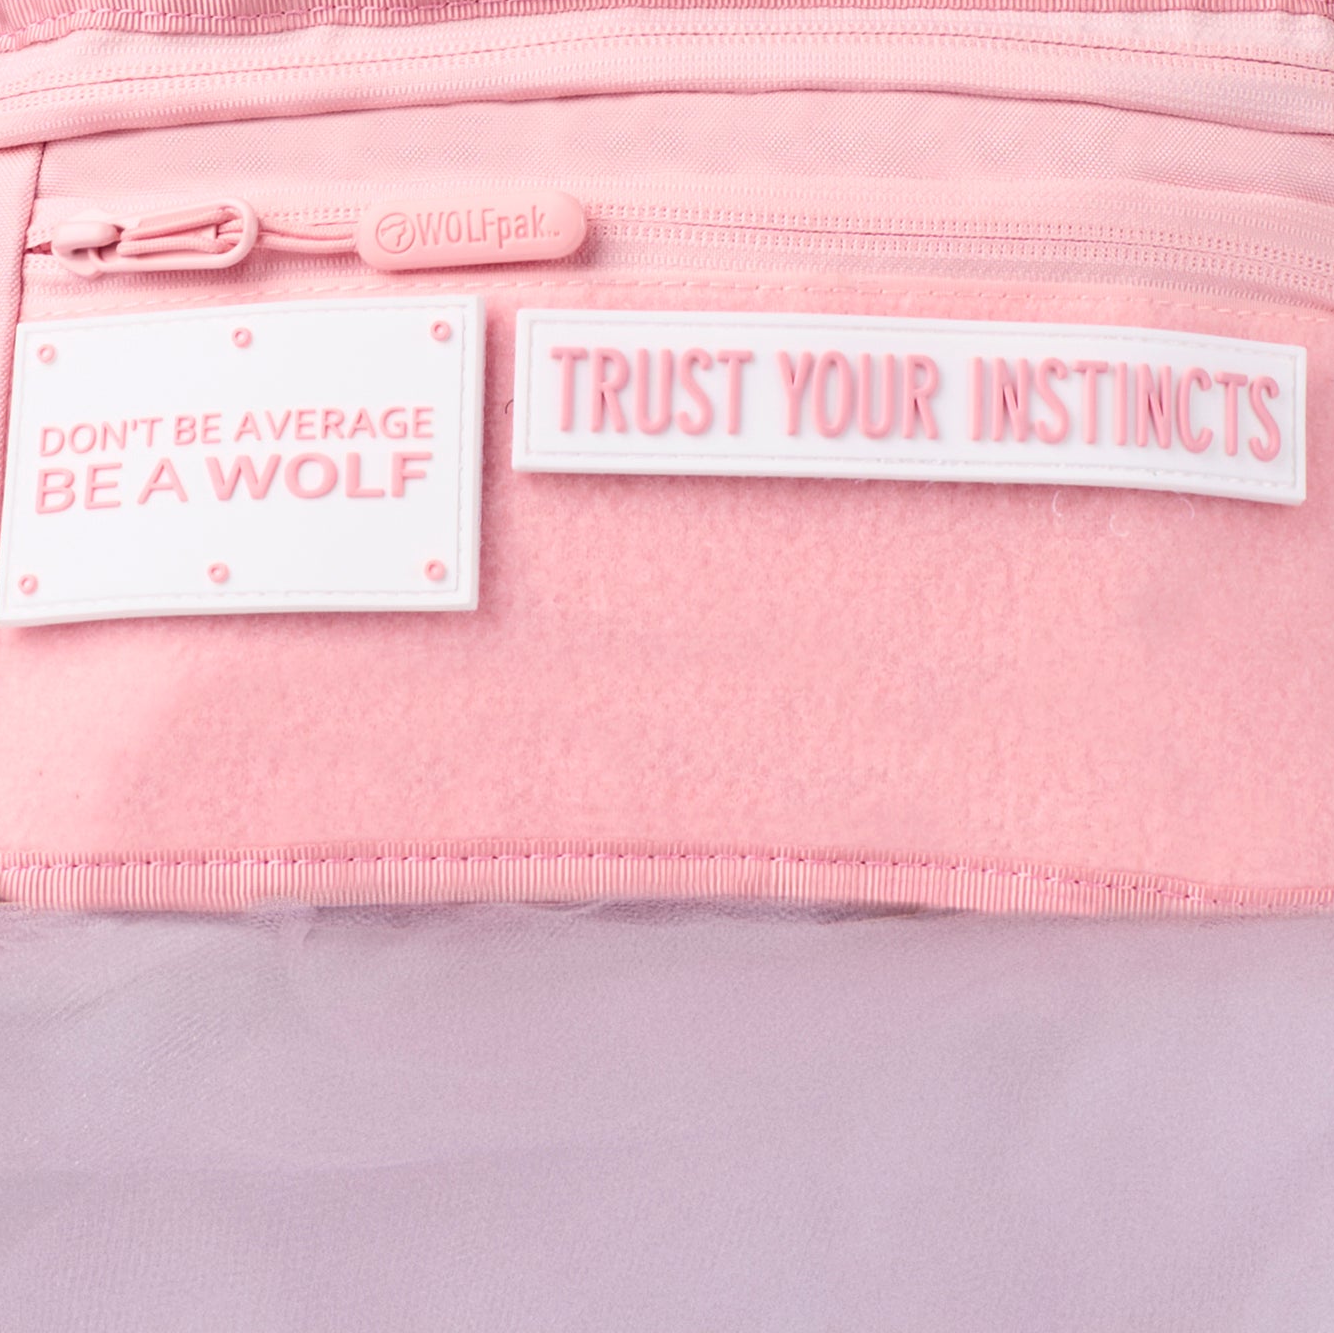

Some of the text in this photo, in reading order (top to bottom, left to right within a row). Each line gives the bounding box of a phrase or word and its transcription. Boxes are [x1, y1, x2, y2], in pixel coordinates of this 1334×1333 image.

[39, 406, 435, 458] DON'T BE AVERAGE
[549, 346, 1282, 463] TRUST YOUR INSTINCTS
[34, 450, 434, 515] BE A WOLF
